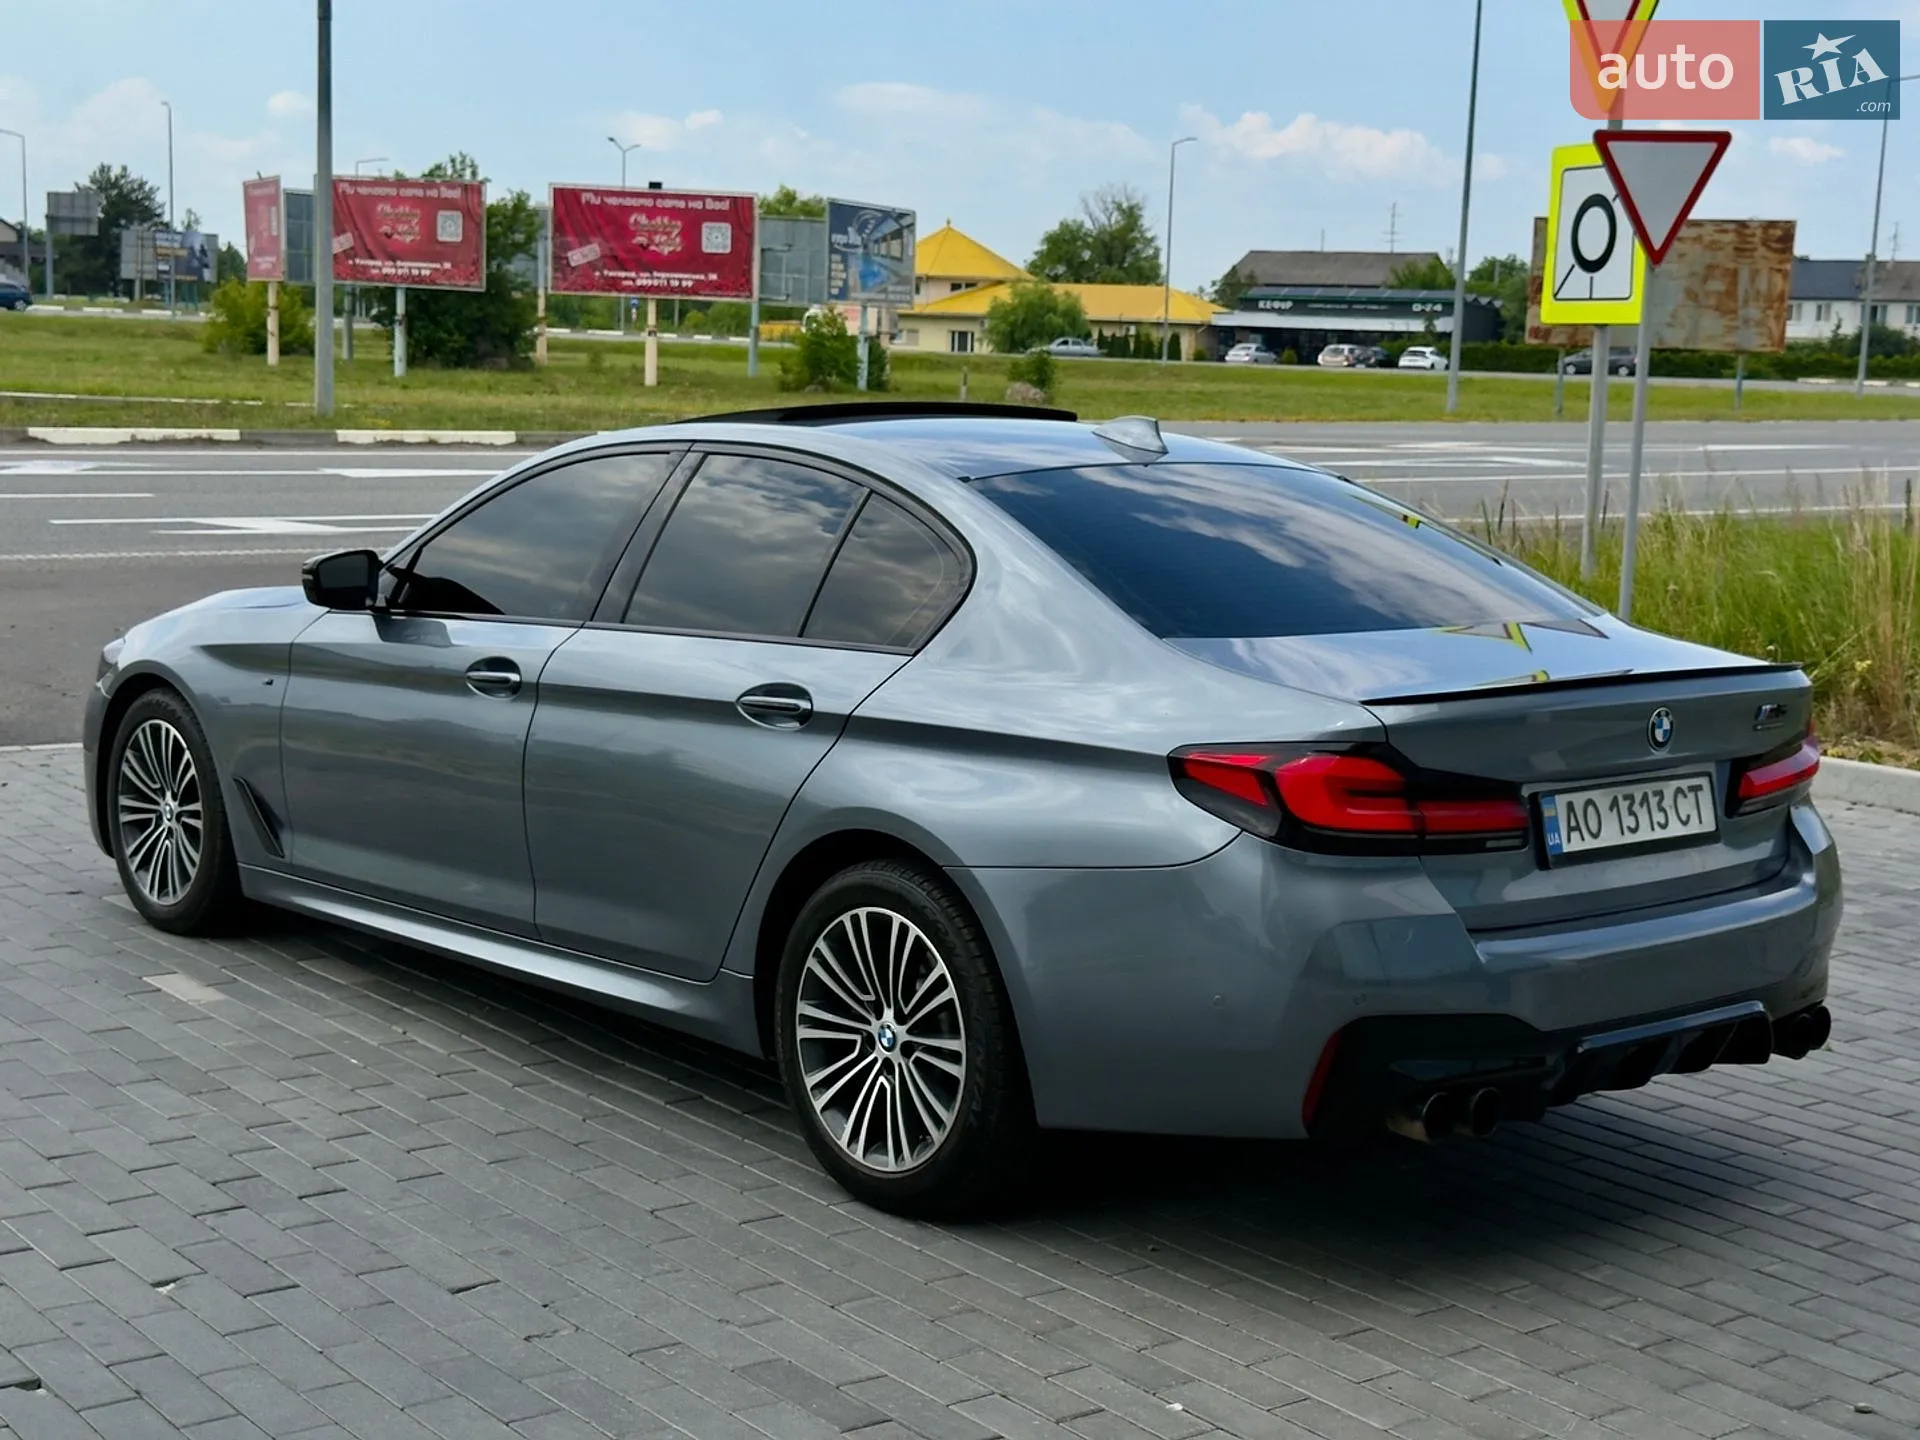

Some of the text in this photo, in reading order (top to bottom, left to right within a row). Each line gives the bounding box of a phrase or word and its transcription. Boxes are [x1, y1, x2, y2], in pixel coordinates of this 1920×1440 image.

[1566, 784, 1704, 844] AO 1313 CT
[1547, 833, 1560, 846] UA
